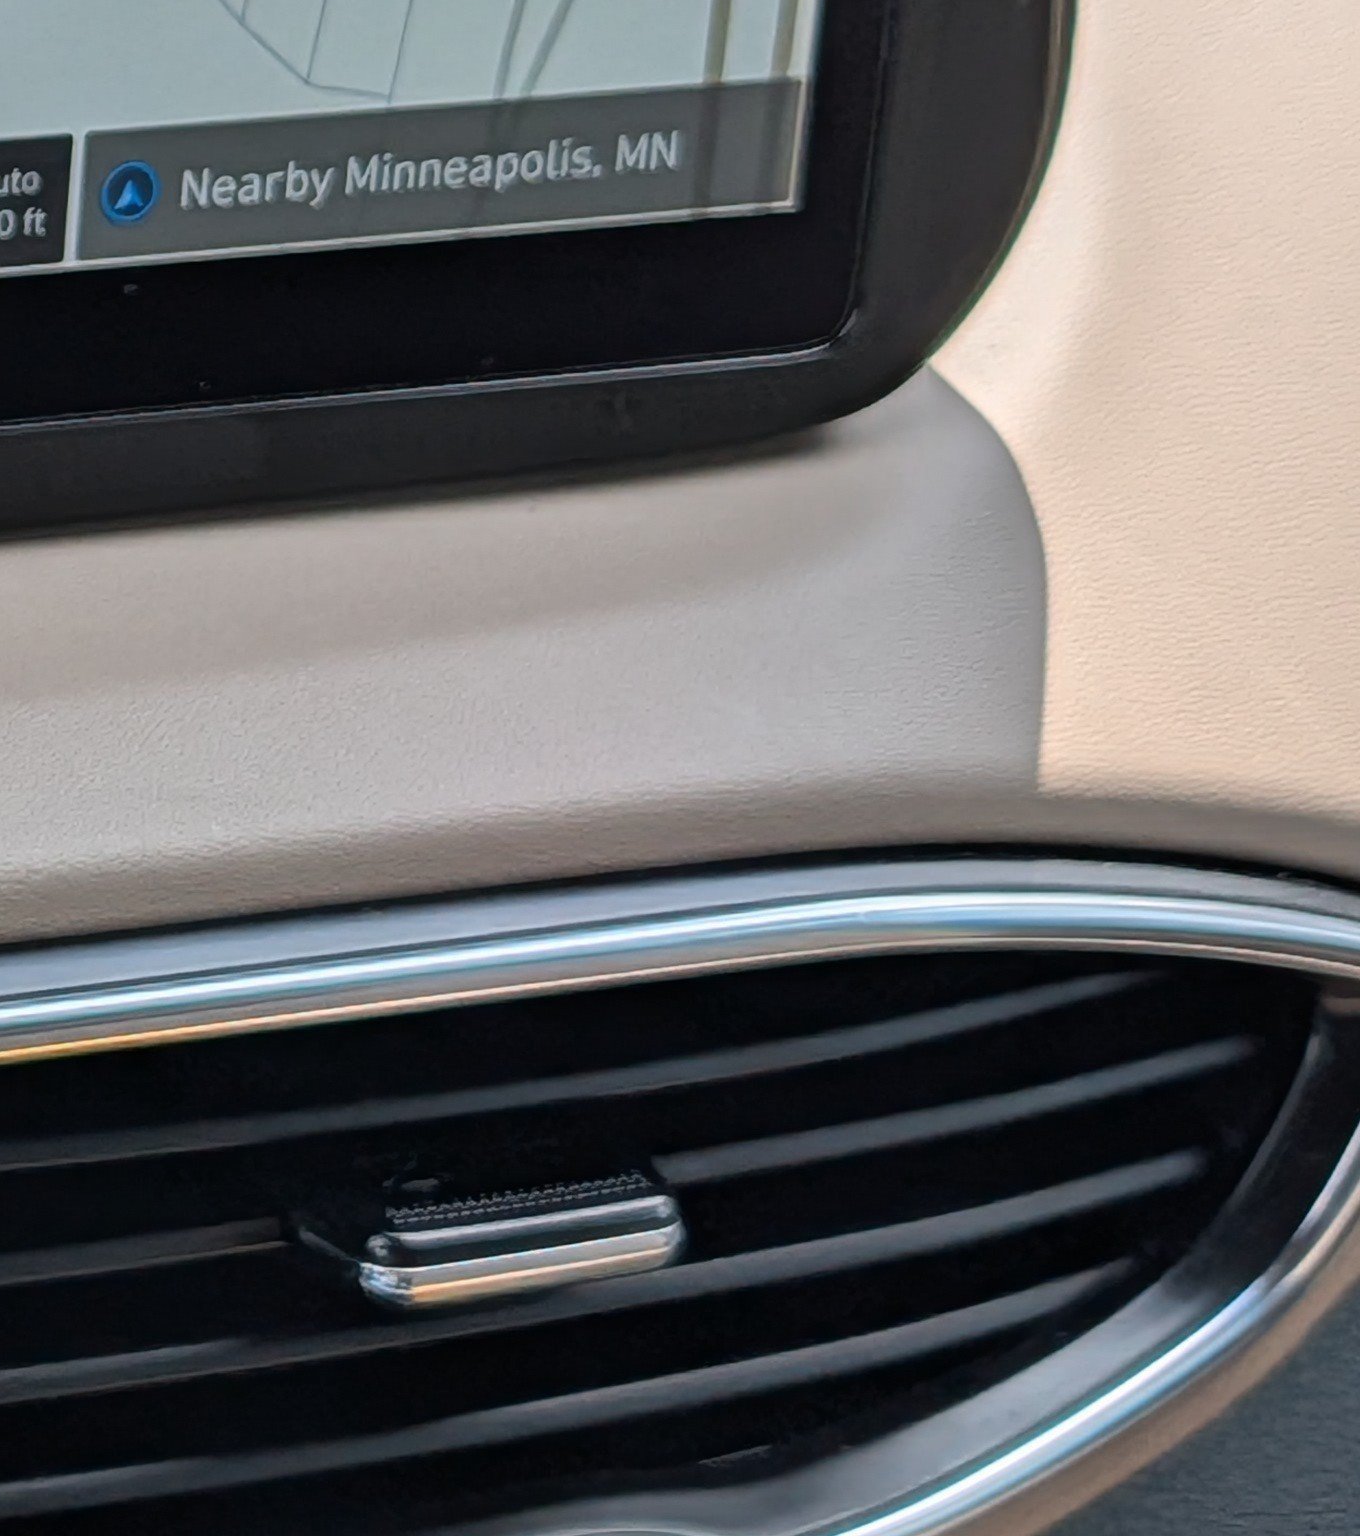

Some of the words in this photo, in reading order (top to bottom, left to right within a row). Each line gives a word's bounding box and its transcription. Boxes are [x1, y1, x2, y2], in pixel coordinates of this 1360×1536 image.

[180, 160, 335, 210] Nearby
[344, 137, 603, 195] Minneapolis,
[614, 130, 680, 173] MN
[22, 205, 49, 237] ft
